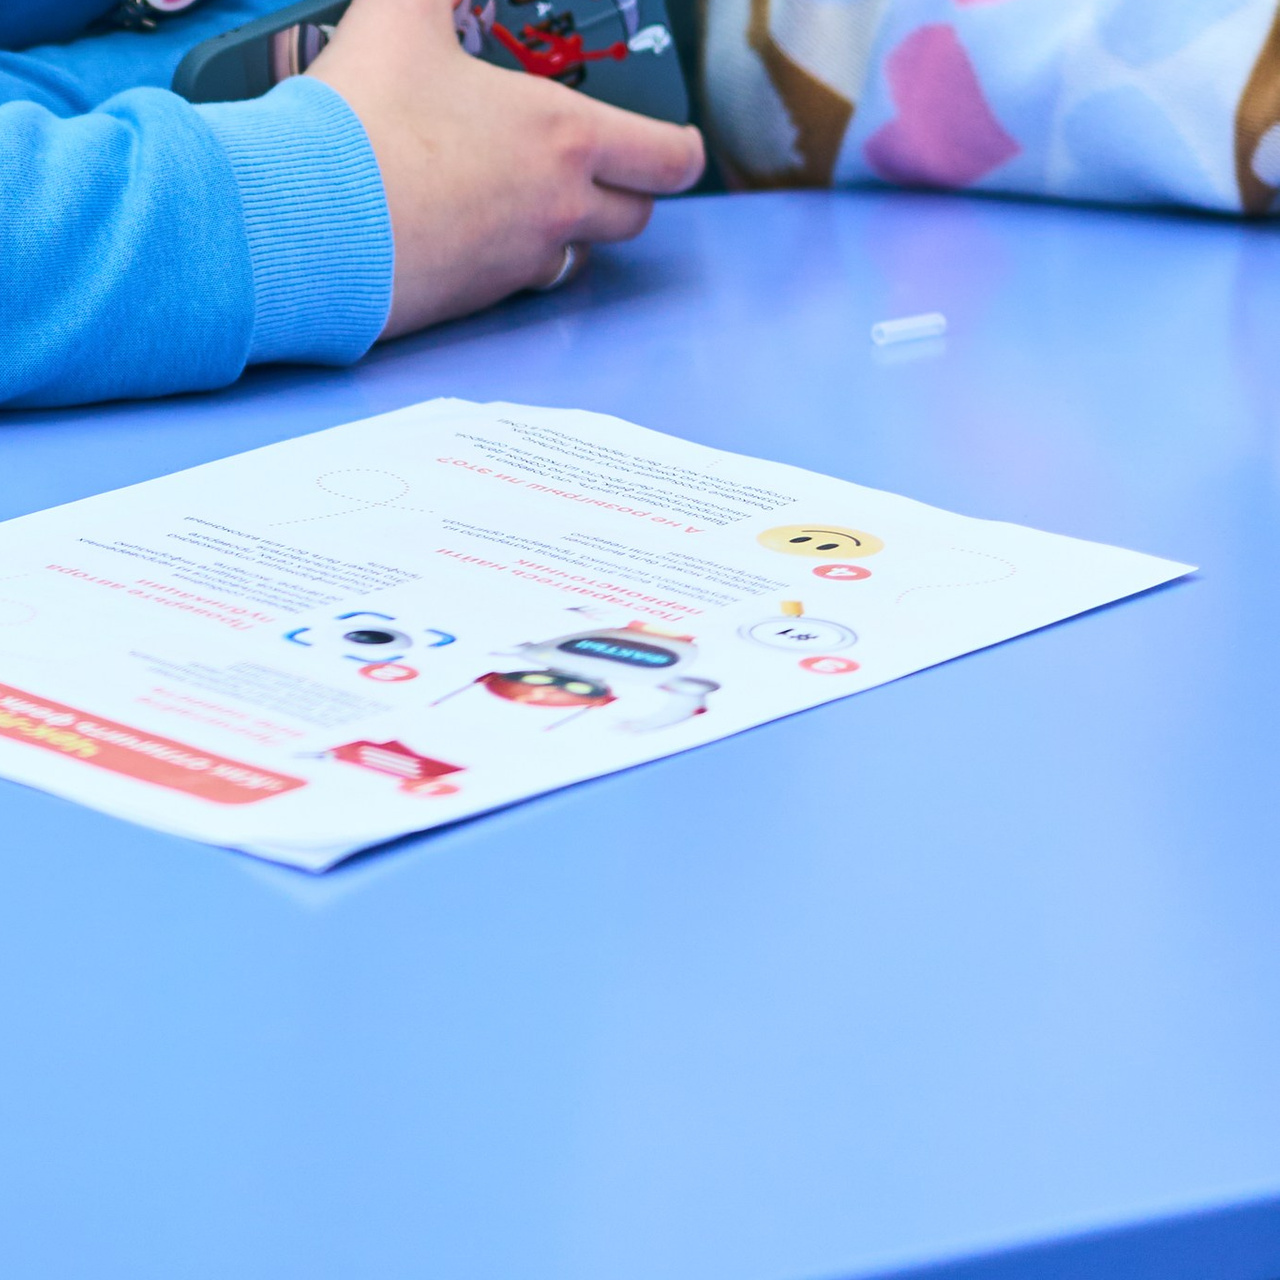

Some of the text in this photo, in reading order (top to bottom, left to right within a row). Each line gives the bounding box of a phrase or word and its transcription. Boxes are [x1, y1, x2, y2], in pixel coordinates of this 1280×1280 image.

[432, 456, 707, 535] А не розыгрыш ли это?
[428, 547, 688, 622] Постарайтесь найти
[508, 558, 707, 615] первоисточник
[825, 567, 857, 577] 4
